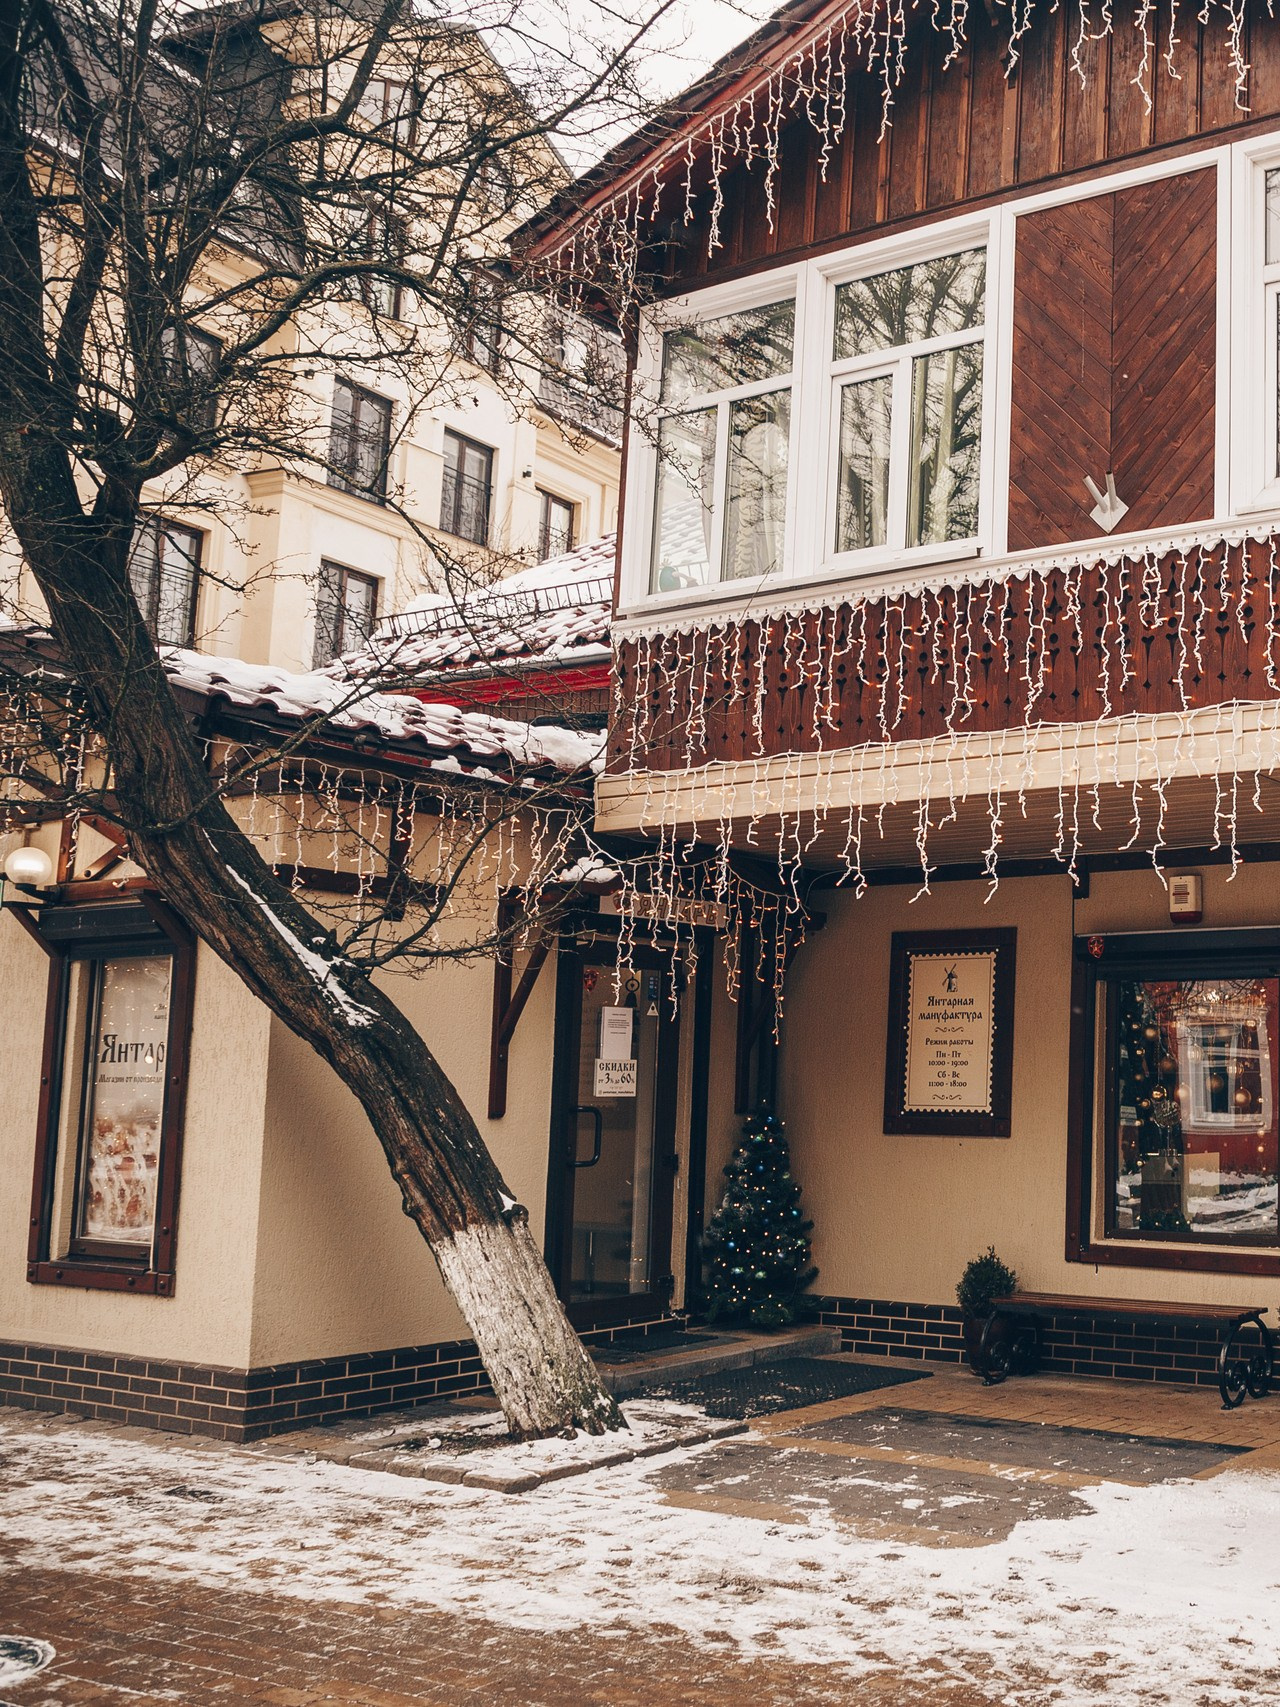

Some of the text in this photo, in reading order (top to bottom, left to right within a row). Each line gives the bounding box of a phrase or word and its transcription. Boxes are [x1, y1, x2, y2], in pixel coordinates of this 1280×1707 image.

[637, 896, 718, 925] ЯНТАРЬ
[927, 995, 974, 1008] Янтарная
[918, 1009, 983, 1023] мануфактура
[925, 1037, 974, 1047] Режим работы
[936, 1050, 947, 1058] Пн
[951, 1050, 962, 1058] Пт
[937, 1070, 947, 1079] Сб
[949, 1079, 968, 1088] 18:00
